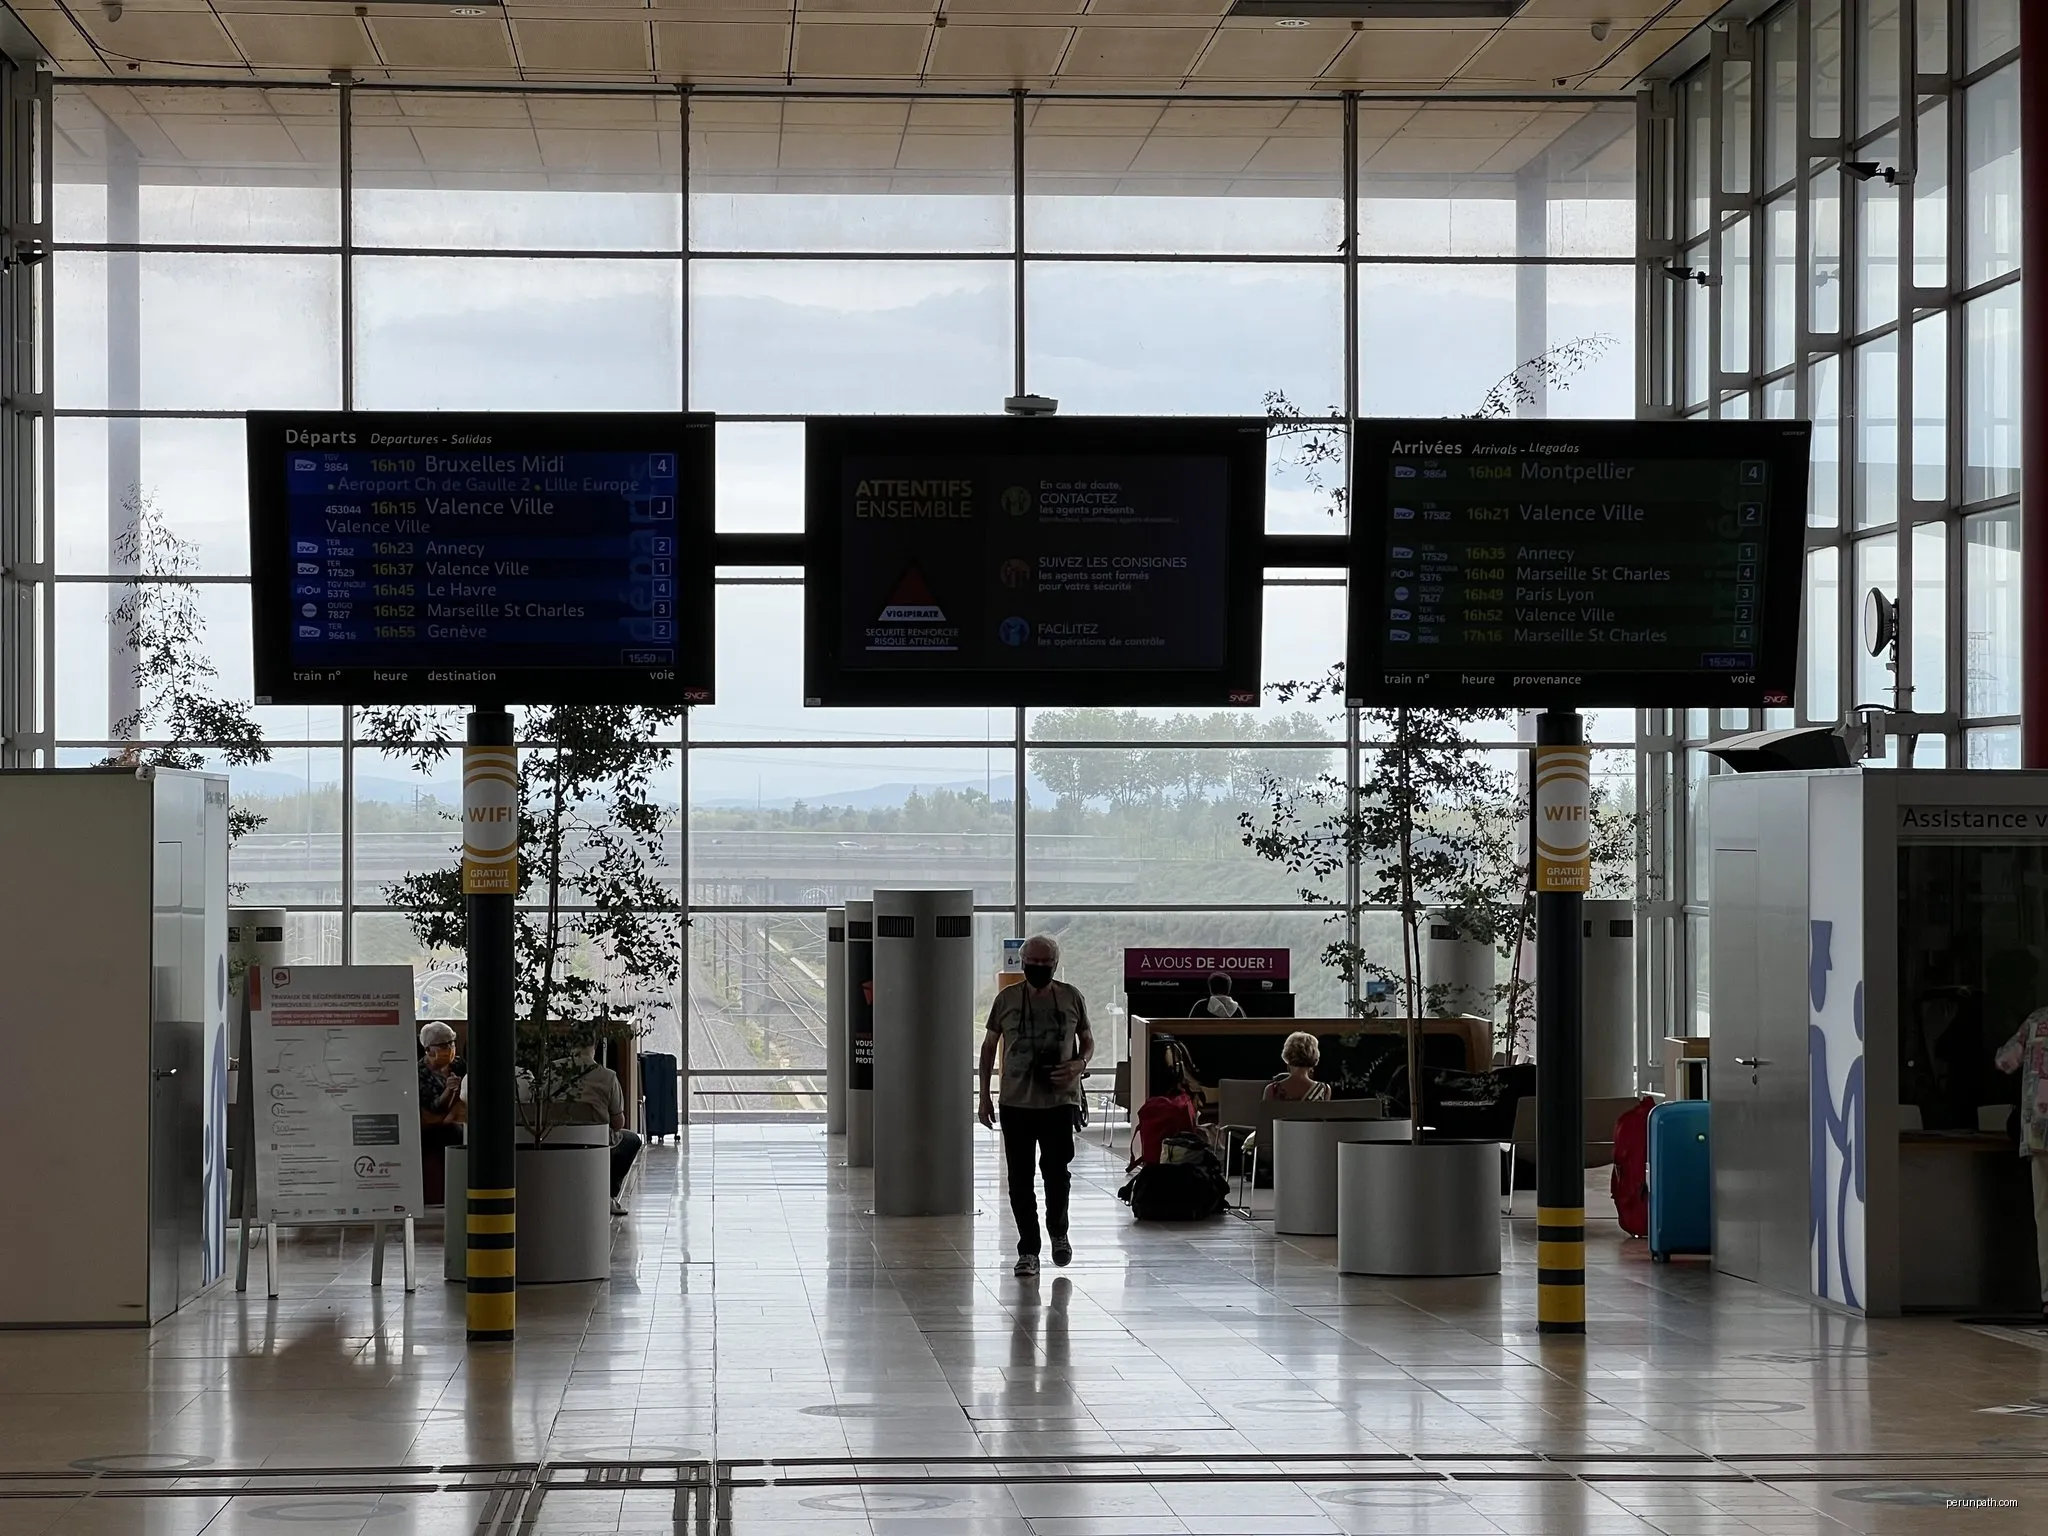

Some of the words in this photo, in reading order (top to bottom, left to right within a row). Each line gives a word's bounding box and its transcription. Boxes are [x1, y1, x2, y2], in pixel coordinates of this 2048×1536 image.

[286, 429, 356, 447] Départs
[370, 433, 438, 446] Departures
[451, 434, 492, 445] Salidas
[1391, 440, 1462, 455] Arrivées
[1472, 444, 1517, 455] Arrivals
[1529, 443, 1580, 454] Llegadas
[324, 463, 349, 472] 9864
[370, 459, 416, 473] 16h10
[425, 455, 516, 473] Bruxelles
[522, 456, 564, 473] Midi
[657, 459, 667, 472] 4
[1468, 466, 1512, 479] 16h04
[1521, 462, 1635, 484] Montpellier
[1749, 467, 1758, 479] 4
[338, 478, 409, 493] Aeroport
[415, 477, 436, 491] Ch
[442, 478, 461, 491] de
[466, 478, 516, 492] Gaulle
[521, 478, 530, 491] 2
[544, 477, 578, 491] Lille
[583, 478, 640, 495] Europe
[856, 480, 973, 498] ATTENTIFS
[1040, 480, 1053, 490] En
[1056, 482, 1072, 490] cas
[1074, 480, 1087, 490] de
[1040, 493, 1118, 504] CONTACTEZ
[325, 506, 361, 515] 453044
[371, 501, 416, 515] 16h15
[425, 498, 504, 515] Valence
[510, 498, 554, 515] Ville
[657, 501, 666, 514] J
[856, 500, 973, 518] ENSEMBLE
[1040, 505, 1053, 514] les
[1056, 506, 1090, 516] agents
[1092, 505, 1135, 516] présents
[1467, 508, 1510, 521] 16h21
[1520, 504, 1596, 521] Valence
[1602, 504, 1645, 521] Ville
[1746, 508, 1755, 520] 2
[326, 519, 390, 534] Valence
[395, 519, 430, 534] Ville
[327, 548, 355, 556] 17582
[372, 542, 414, 555] 16h23
[426, 541, 485, 558] Annecy
[659, 542, 666, 551] 2
[1465, 548, 1505, 560] 16h35
[1517, 547, 1575, 563] Annecy
[1746, 549, 1752, 557] 1
[327, 568, 355, 577] 17529
[372, 563, 414, 576] 16h37
[426, 562, 489, 576] Valence
[495, 562, 529, 576] Ville
[659, 563, 666, 572] 1
[1039, 557, 1083, 568] SUIVEZ
[1087, 557, 1108, 568] LES
[1112, 556, 1188, 568] CONSIGNES
[1039, 570, 1053, 580] les
[1055, 572, 1089, 582] agents
[1091, 571, 1113, 580] sont
[1115, 570, 1150, 580] formés
[1464, 568, 1505, 581] 16h40
[1517, 567, 1586, 581] Marseille
[1591, 567, 1608, 581] St
[1613, 567, 1671, 581] Charles
[1743, 568, 1751, 577] 4
[328, 590, 350, 598] 5376
[372, 584, 415, 597] 16h45
[427, 583, 445, 596] Le
[451, 583, 497, 597] Havre
[658, 584, 667, 593] 4
[1039, 583, 1061, 593] pour
[1064, 582, 1090, 591] votre
[1094, 581, 1132, 591] sécurité
[1463, 588, 1504, 600] 16h49
[1516, 587, 1552, 601] Paris
[1558, 587, 1594, 604] Lyon
[1743, 589, 1750, 598] 3
[328, 611, 351, 619] 7827
[373, 605, 416, 618] 16h52
[427, 604, 499, 618] Marseille
[505, 604, 521, 617] St
[526, 603, 585, 617] Charles
[659, 605, 666, 614] 3
[886, 609, 939, 618] VIGIPIRATE
[1462, 609, 1503, 622] 16h52
[1515, 608, 1576, 622] Valence
[1581, 607, 1615, 622] Ville
[1741, 610, 1748, 619] 2
[373, 626, 416, 639] 16h55
[427, 624, 487, 639] Genève
[659, 626, 666, 635] 2
[1038, 623, 1100, 635] FACILITEZ
[1462, 630, 1503, 642] 17h16
[1514, 629, 1584, 643] Marseille
[1588, 629, 1605, 642] St
[1609, 629, 1667, 643] Charles
[1739, 630, 1747, 639] 4
[874, 637, 907, 646] RISQUE
[909, 637, 950, 646] ATTENTAT
[1037, 637, 1052, 646] les
[1054, 637, 1107, 648] opérations
[1109, 637, 1122, 646] de
[1124, 636, 1166, 646] contrôle
[293, 671, 322, 681] train
[328, 670, 342, 681] n°
[373, 671, 408, 681] heure
[427, 671, 496, 681] destination
[650, 670, 675, 680] voie
[1384, 674, 1412, 684] train
[1417, 673, 1430, 684] n°
[1462, 674, 1496, 685] heure
[1513, 675, 1581, 687] provenance
[1731, 673, 1756, 684] voie
[683, 692, 710, 701] SNCF
[1229, 694, 1255, 703] SNCF
[1762, 695, 1789, 704] SNCF
[468, 806, 513, 823] WIFI
[1544, 805, 1587, 821] WIFI
[1902, 807, 2028, 828] Assistance
[470, 868, 510, 878] GRATUIT
[1547, 867, 1585, 876] GRATUIT
[1141, 953, 1151, 969] À
[1155, 956, 1192, 969] VOUS
[1196, 957, 1216, 969] DE
[1219, 957, 1265, 969] JOUER
[855, 1039, 873, 1047] VOUS
[357, 1163, 374, 1174] 74
